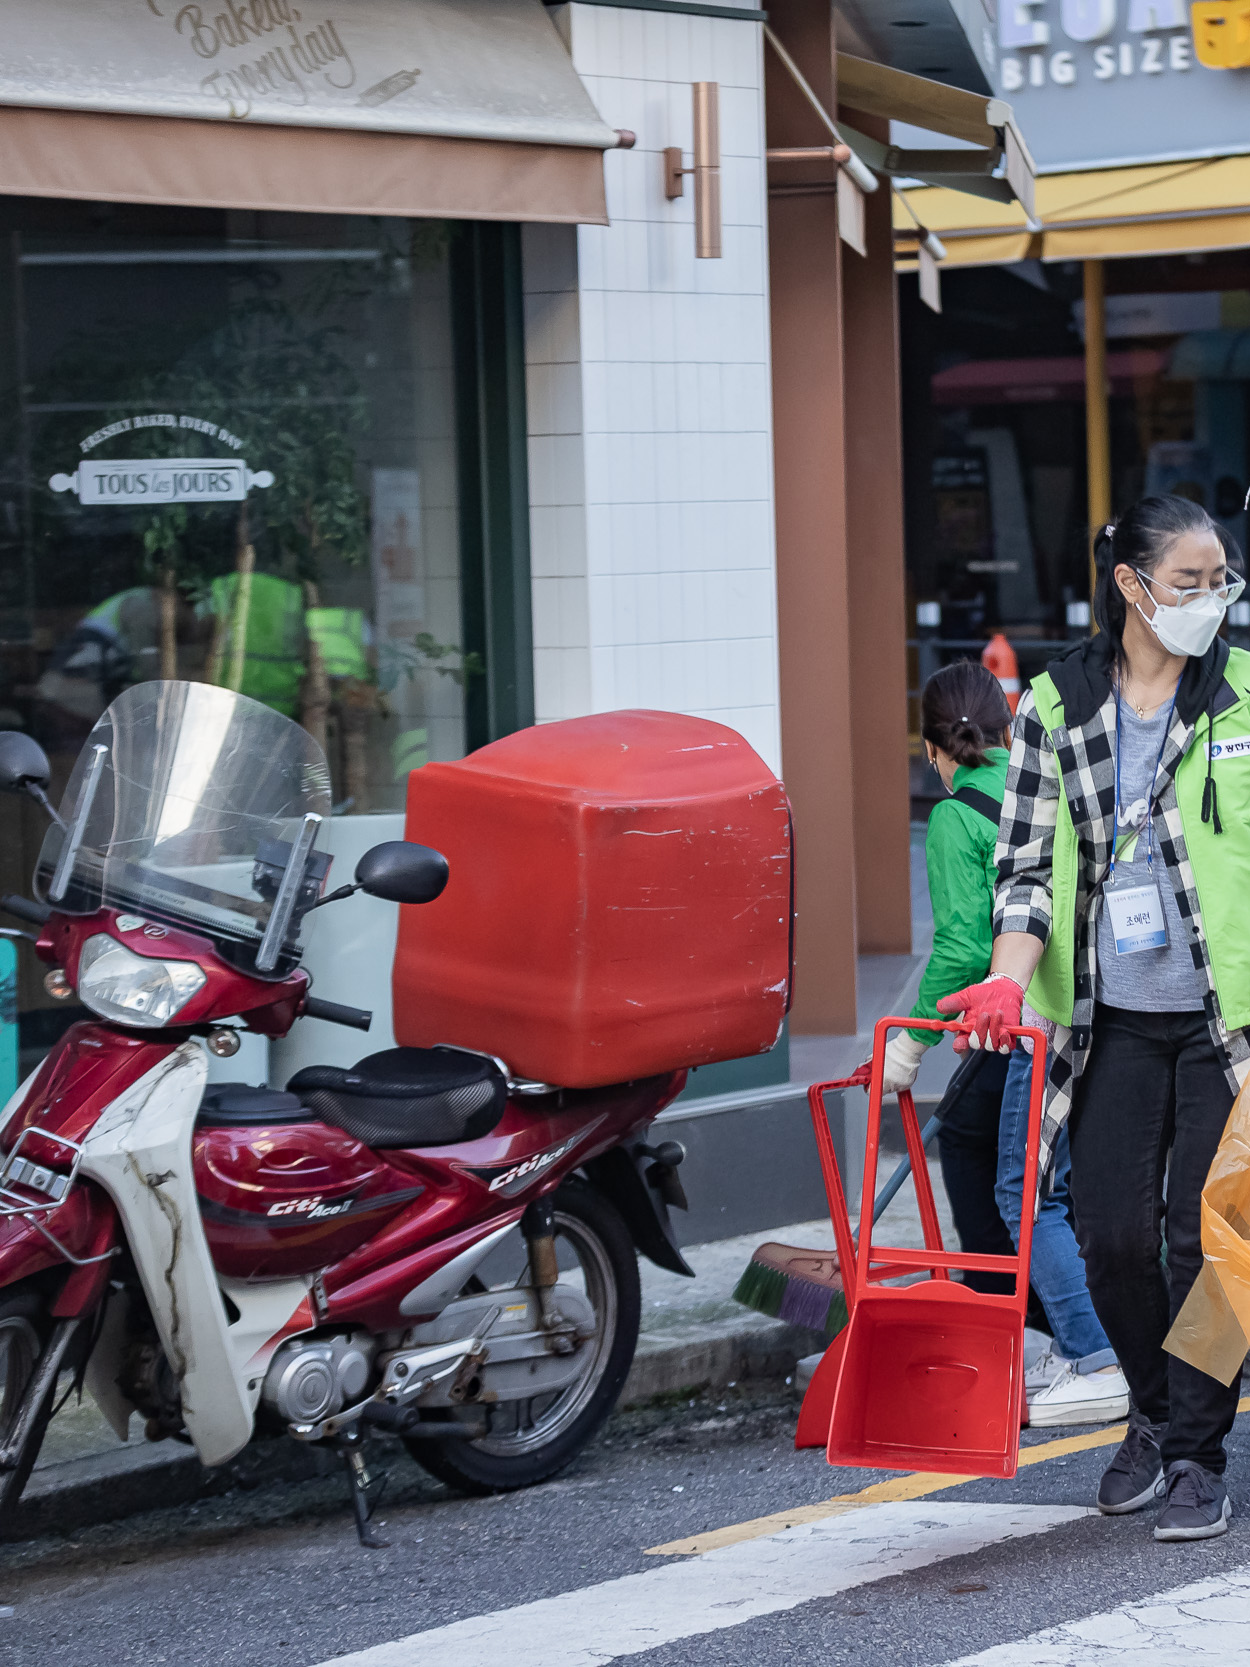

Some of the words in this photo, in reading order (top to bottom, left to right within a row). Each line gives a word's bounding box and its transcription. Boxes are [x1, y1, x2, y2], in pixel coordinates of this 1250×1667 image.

[1001, 50, 1076, 91] BIG
[1092, 36, 1191, 80] SIZE
[94, 474, 148, 495] TOUS
[170, 472, 232, 500] JOURS
